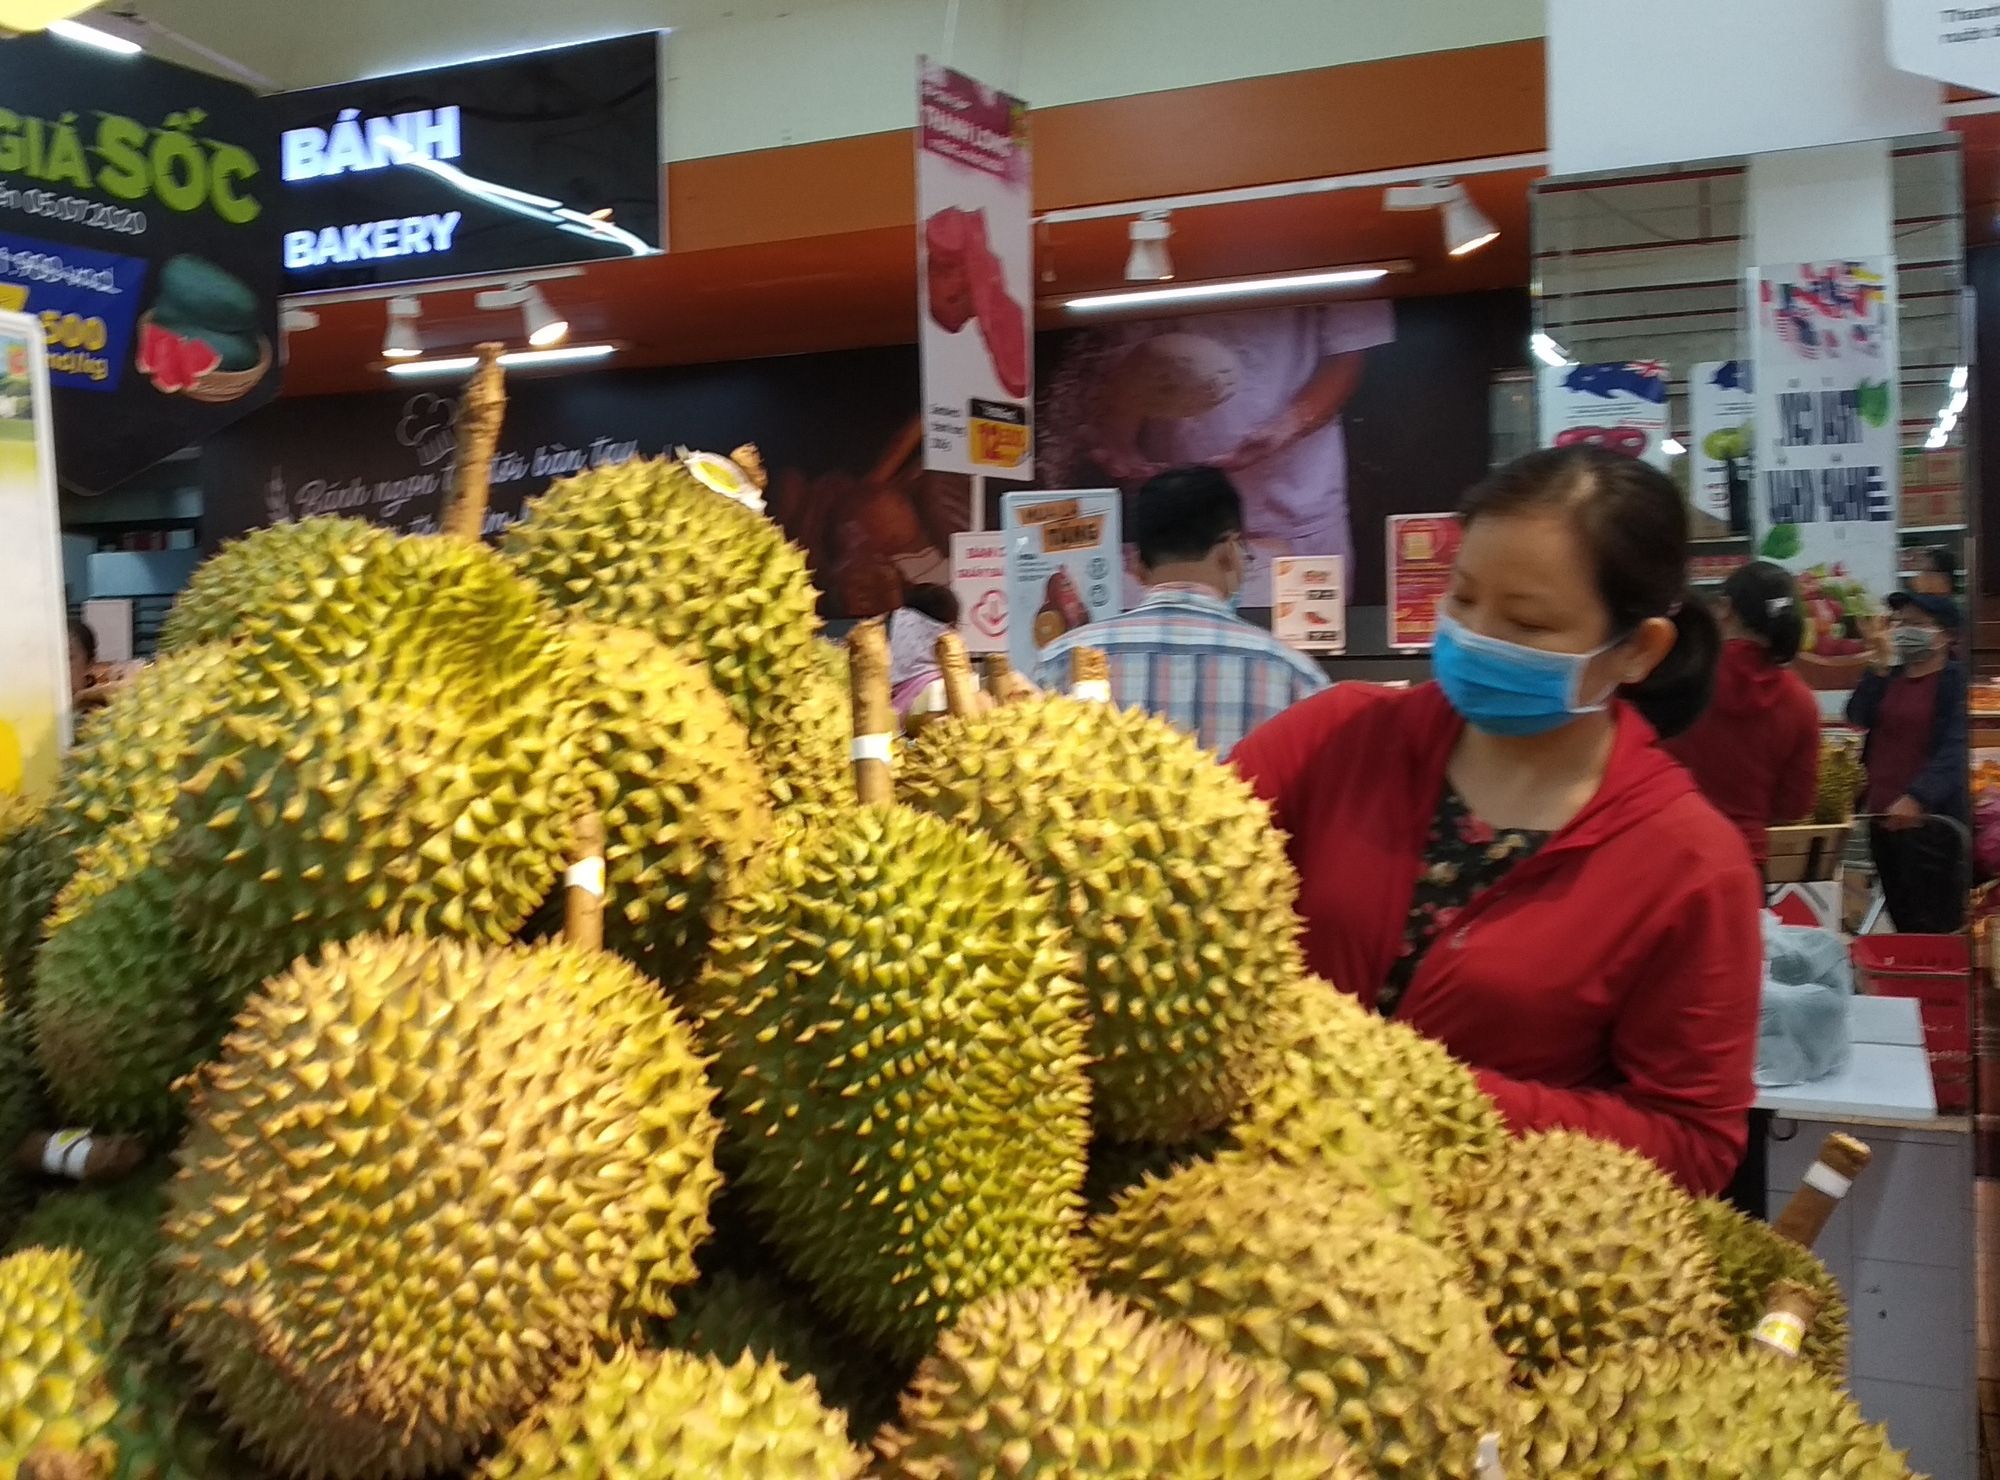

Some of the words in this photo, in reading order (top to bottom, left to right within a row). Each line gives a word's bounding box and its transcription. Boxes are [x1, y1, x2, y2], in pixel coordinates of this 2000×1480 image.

[89, 106, 262, 224] SỐC
[281, 105, 461, 183] BÁNH
[22, 188, 147, 235] 05.07.2020
[284, 211, 462, 269] BAKERY
